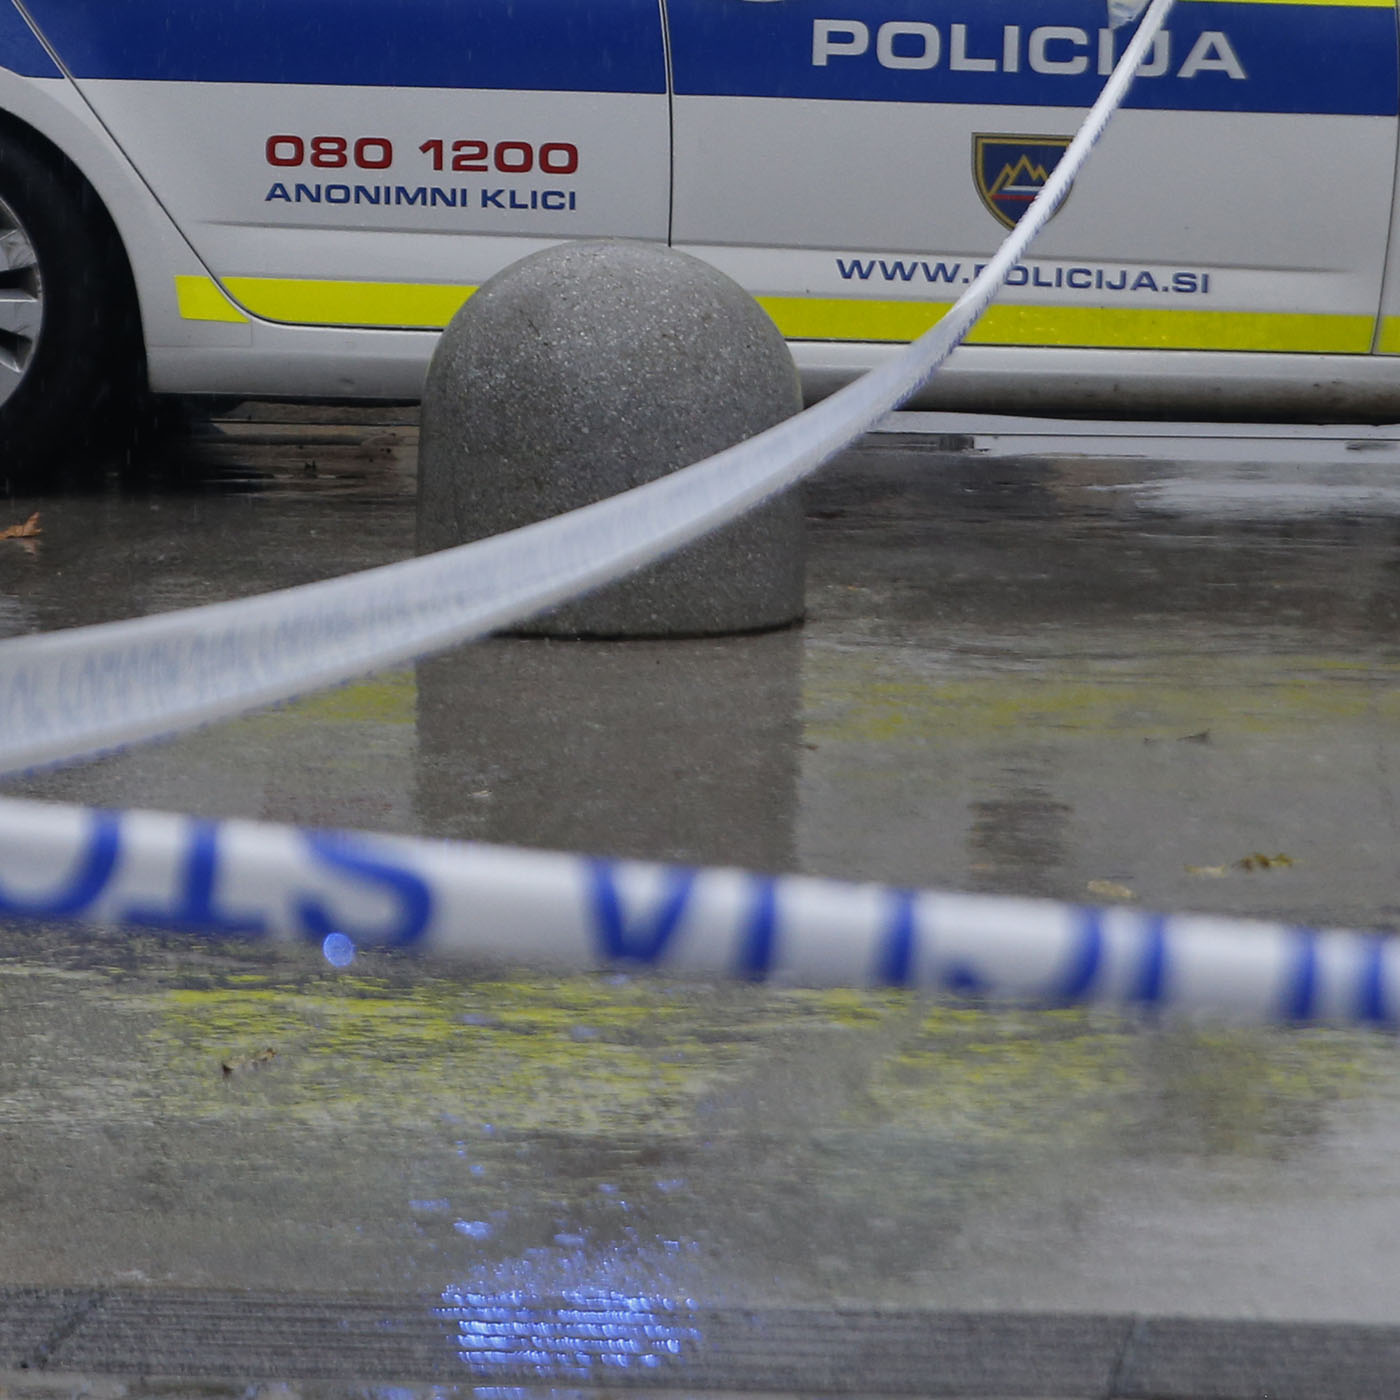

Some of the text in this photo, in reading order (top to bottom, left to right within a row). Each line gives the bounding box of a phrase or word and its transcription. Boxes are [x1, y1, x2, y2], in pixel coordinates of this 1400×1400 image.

[811, 18, 1248, 80] POLICIJA
[265, 135, 579, 175] 080 1200
[264, 182, 576, 211] ANONIMNI KLICI
